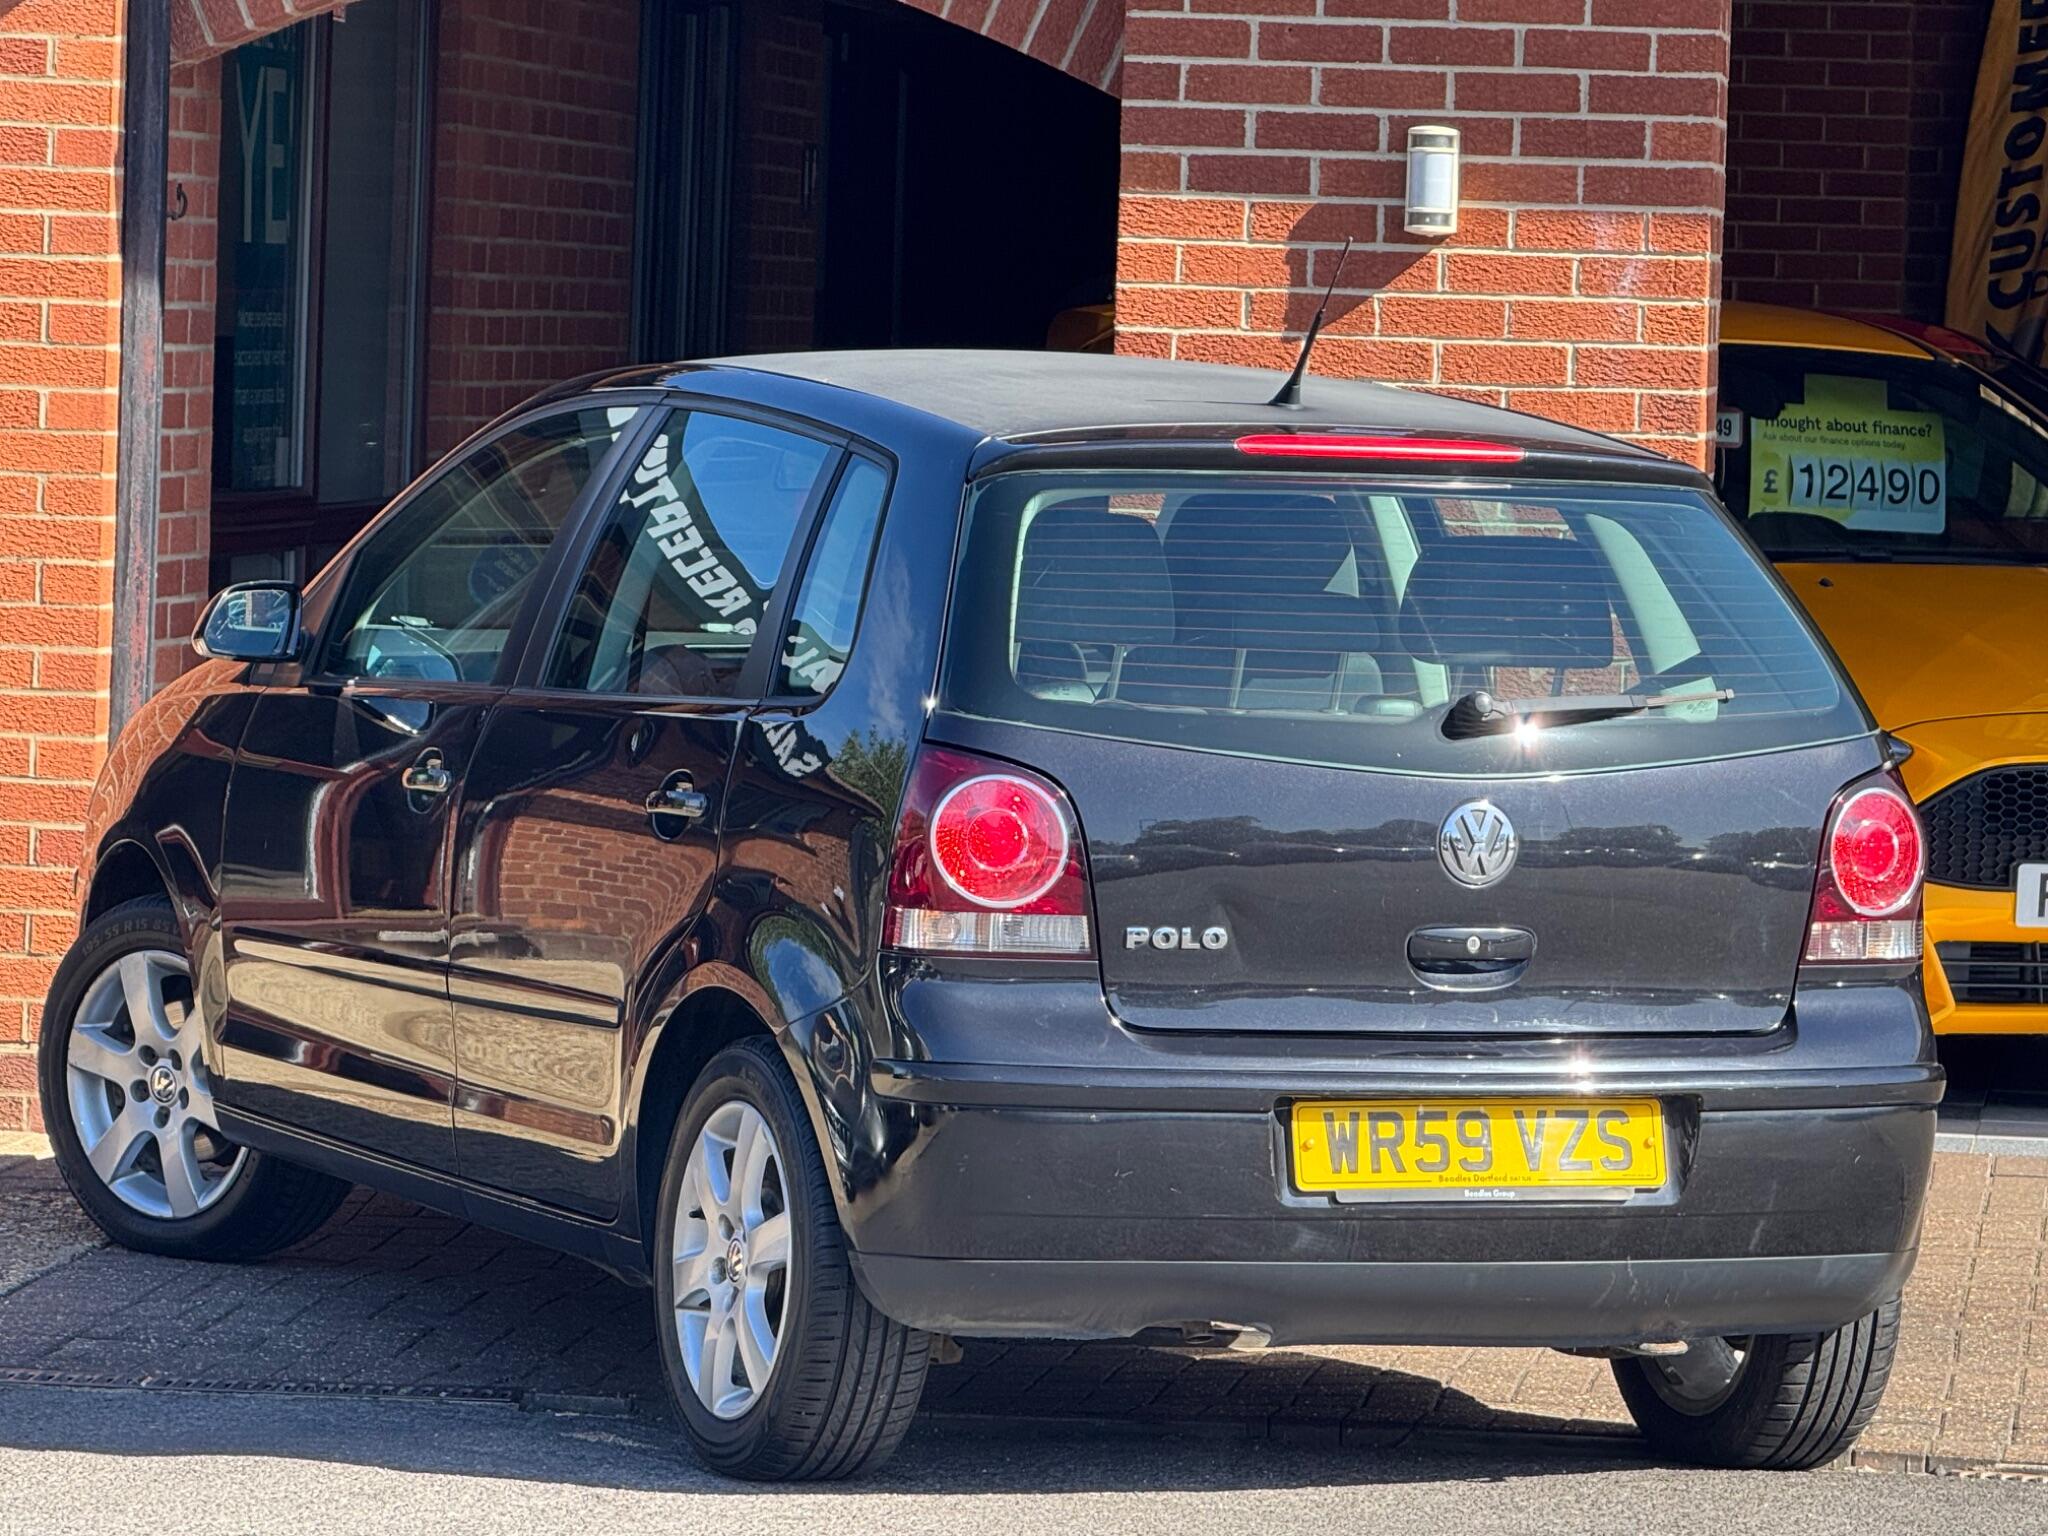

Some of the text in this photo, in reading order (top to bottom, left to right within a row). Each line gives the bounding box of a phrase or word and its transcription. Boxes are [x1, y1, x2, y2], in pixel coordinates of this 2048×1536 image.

[236, 62, 294, 244] YE
[1827, 418, 1868, 434] about
[1872, 420, 1933, 438] finance?
[1851, 438, 1881, 448] options
[1125, 926, 1229, 950] POLO
[1322, 1109, 1633, 1174] WR59 VZS
[1438, 1174, 1471, 1183] Beadles
[1473, 1173, 1508, 1182] Dartford
[1492, 1189, 1515, 1199] Group
